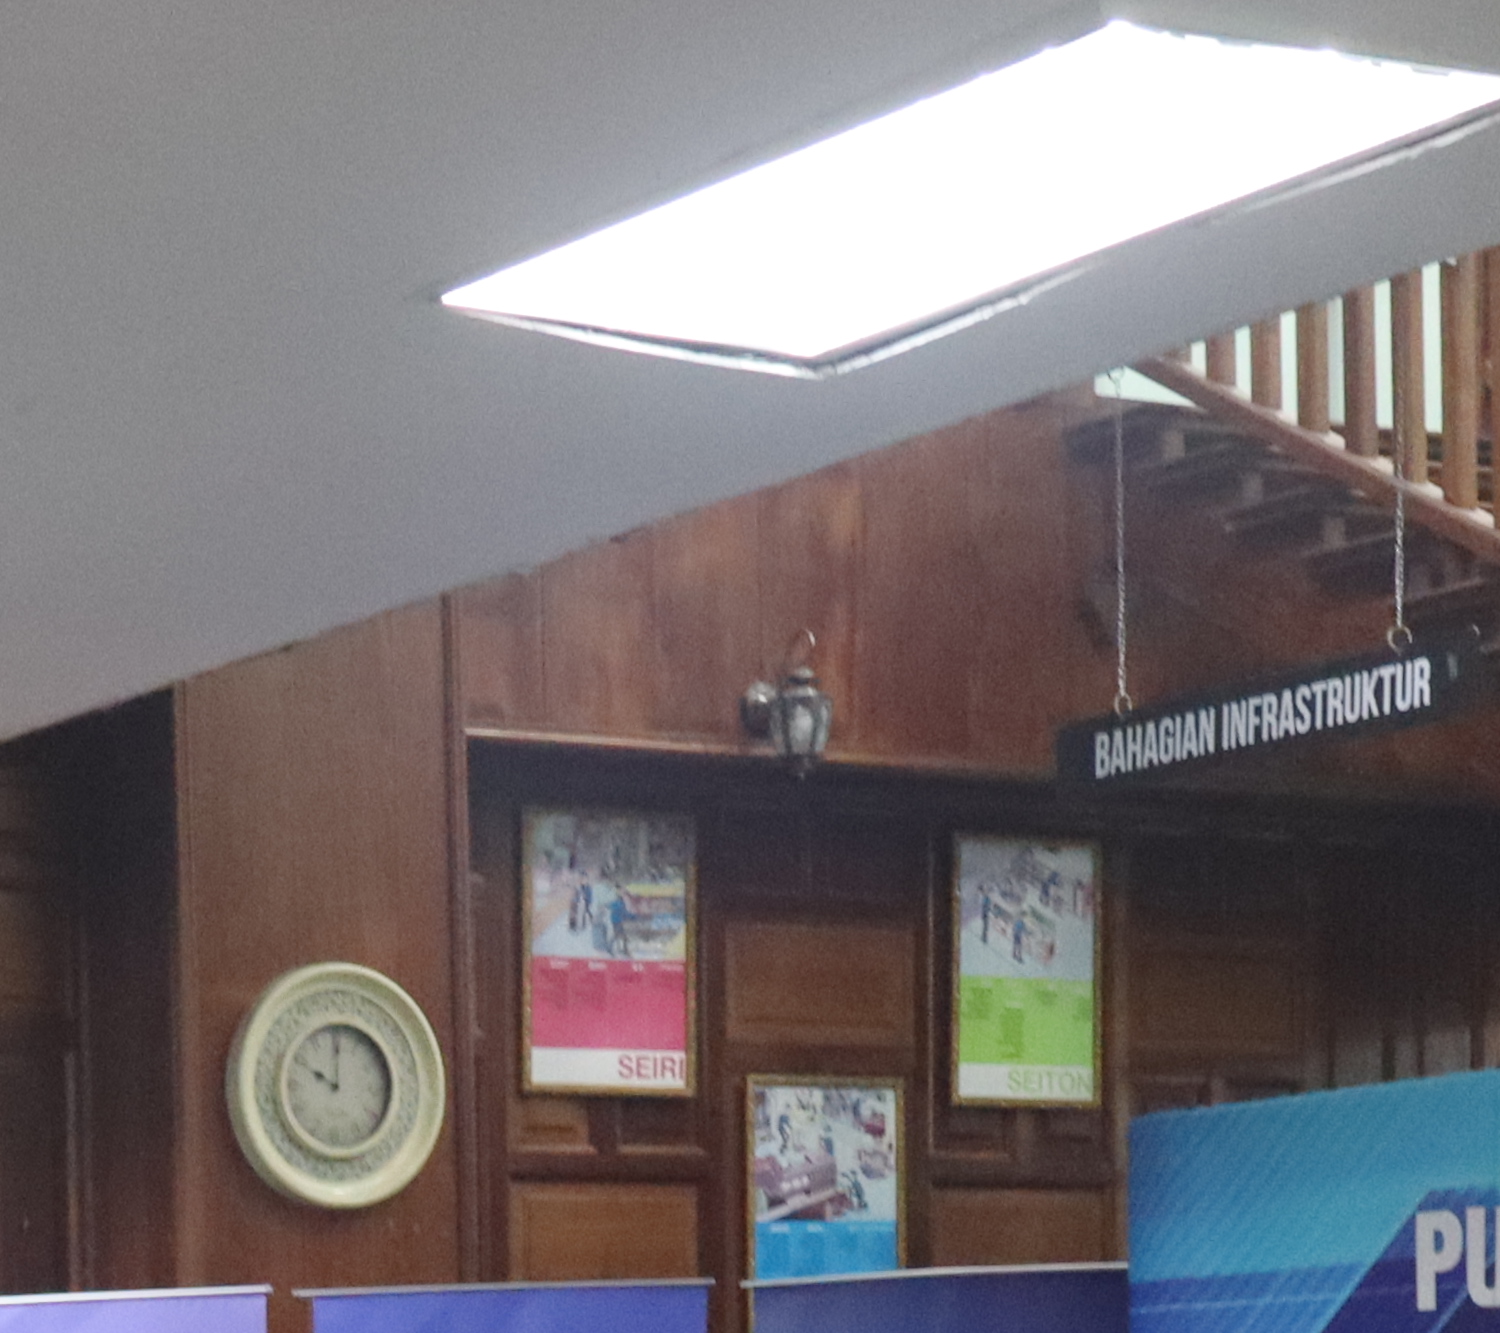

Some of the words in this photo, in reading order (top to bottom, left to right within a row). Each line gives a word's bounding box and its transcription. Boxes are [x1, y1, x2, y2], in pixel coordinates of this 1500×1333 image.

[1095, 708, 1216, 780] BAHAGIAN
[1221, 657, 1431, 751] INFRASTRUKTUR
[618, 1054, 684, 1079] SEIRI
[1008, 1069, 1092, 1094] SEITON
